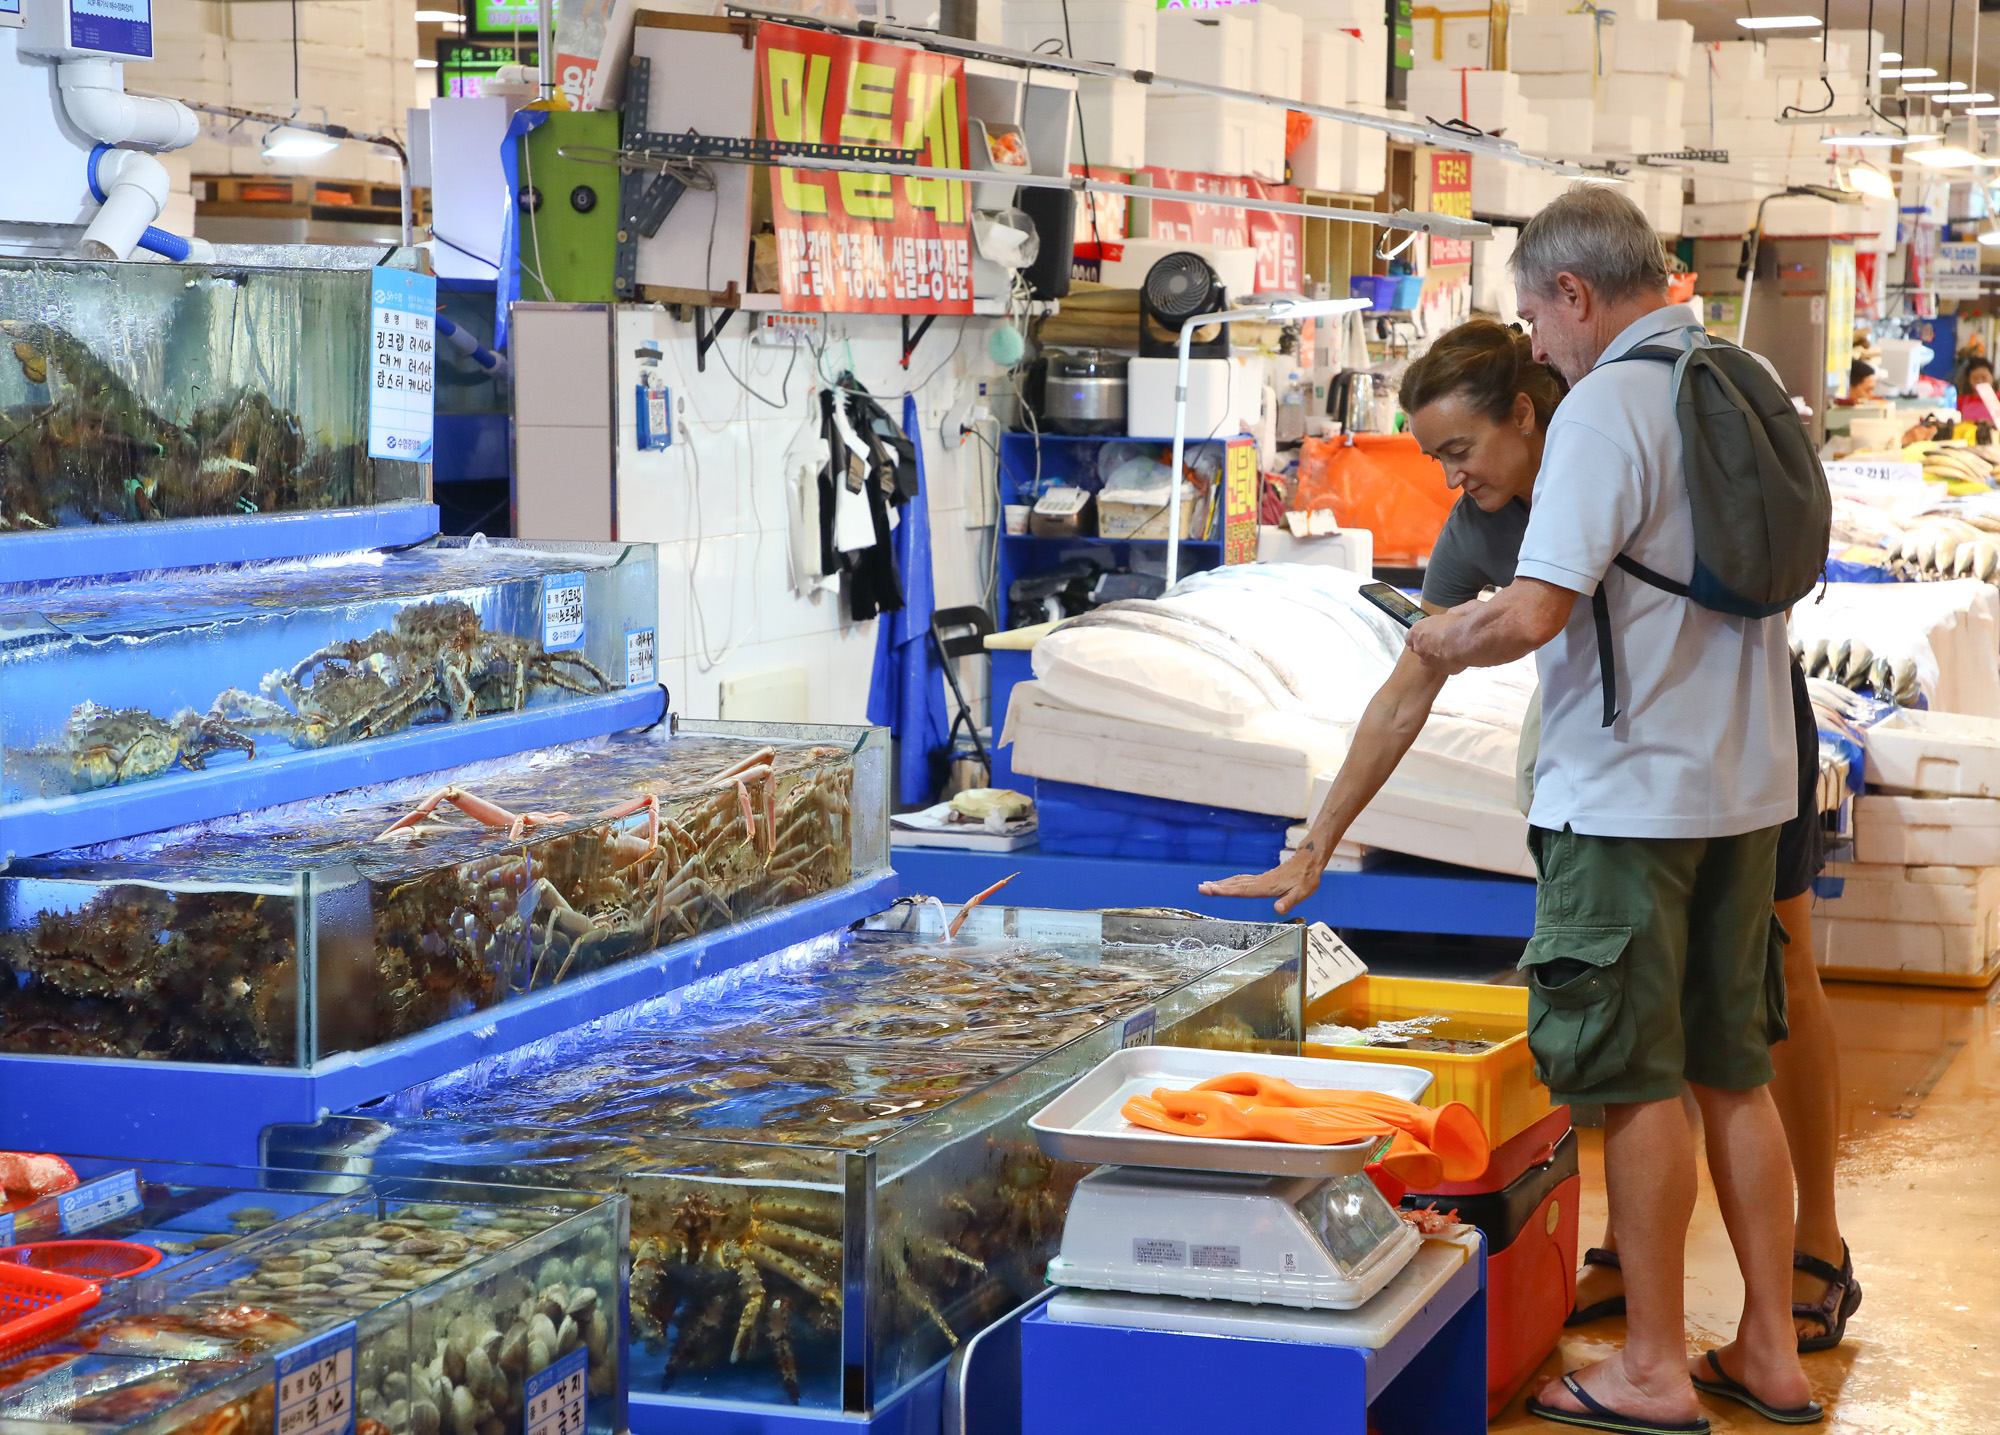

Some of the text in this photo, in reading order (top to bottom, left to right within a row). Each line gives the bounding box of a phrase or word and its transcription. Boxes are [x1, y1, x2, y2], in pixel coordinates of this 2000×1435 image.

[768, 47, 965, 226] 민들레
[1253, 230, 1297, 290] 전문
[409, 336, 432, 353] 러시아
[380, 353, 432, 376] 대게 러시아
[377, 369, 404, 391] 랍스터
[397, 437, 422, 451] 수협중앙회
[557, 1374, 581, 1405] 낙지
[306, 1391, 344, 1428] 국산
